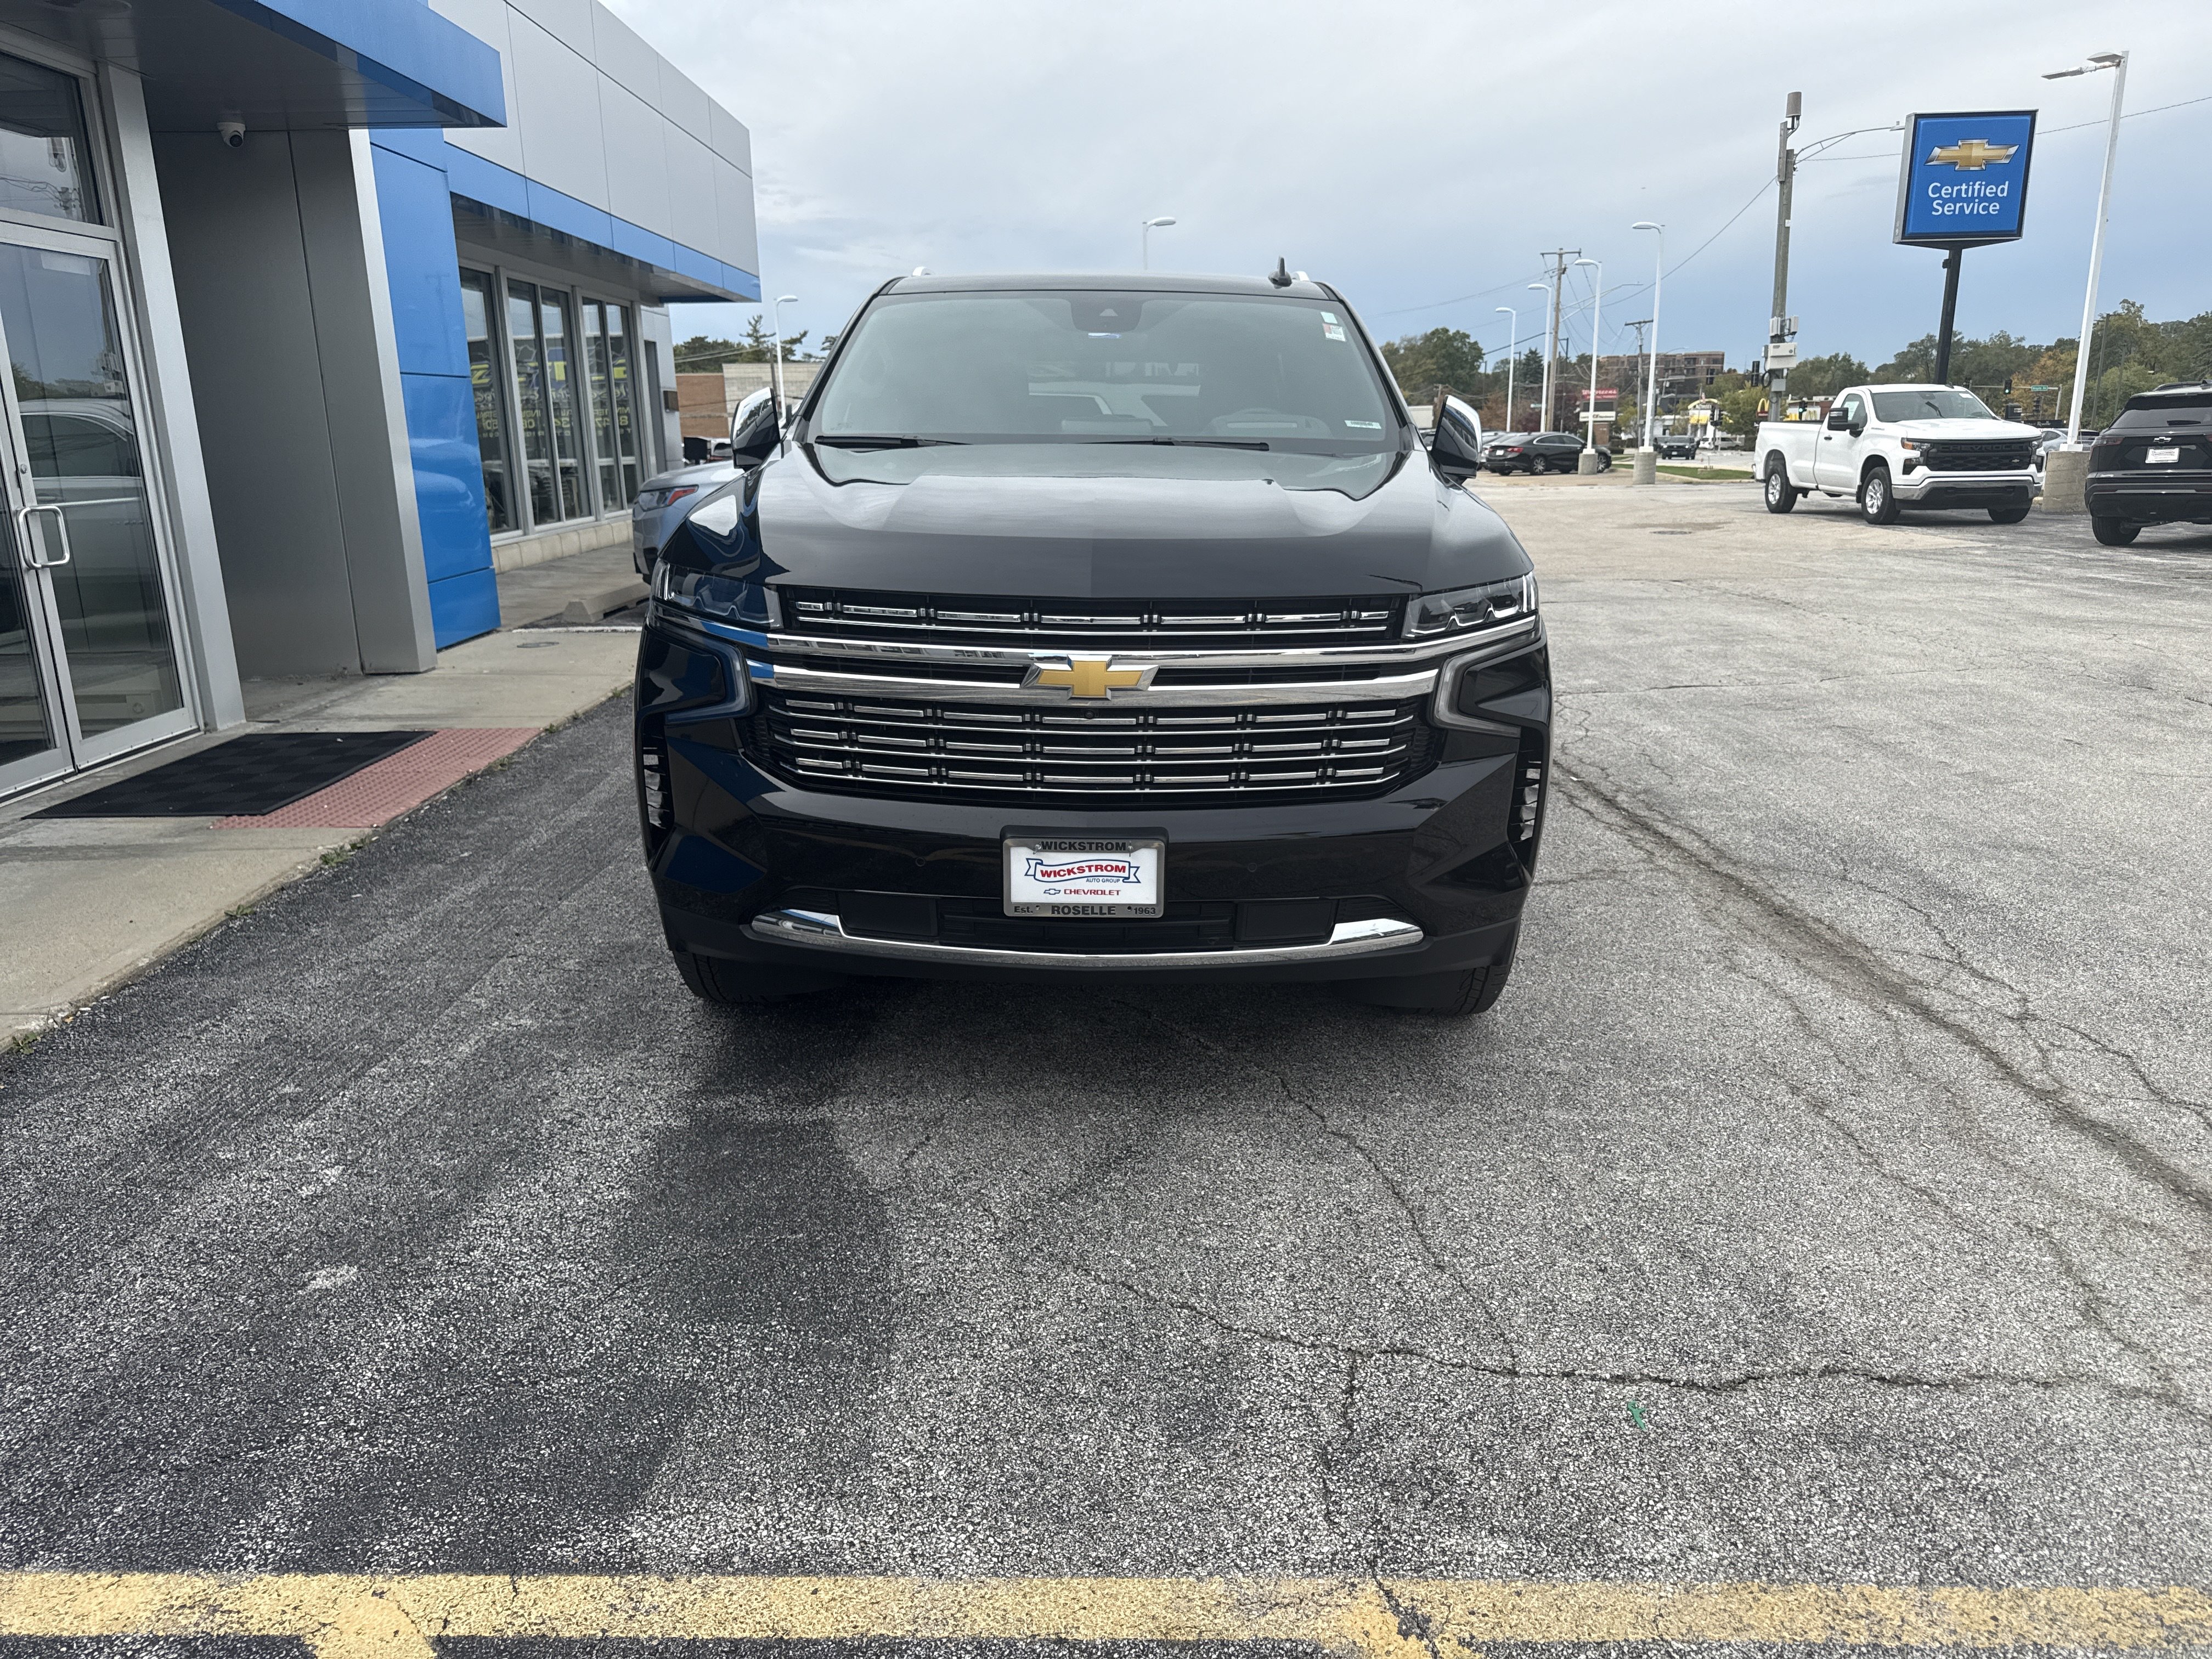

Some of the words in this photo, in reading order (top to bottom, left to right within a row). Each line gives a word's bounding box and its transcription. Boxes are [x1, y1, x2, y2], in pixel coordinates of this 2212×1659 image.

[1928, 180, 2009, 198] Certified
[1932, 199, 2000, 216] Service
[1041, 841, 1126, 851] WICKSTROM
[1040, 864, 1126, 878] WICKSTROM
[1051, 905, 1116, 916] ROSELLE
